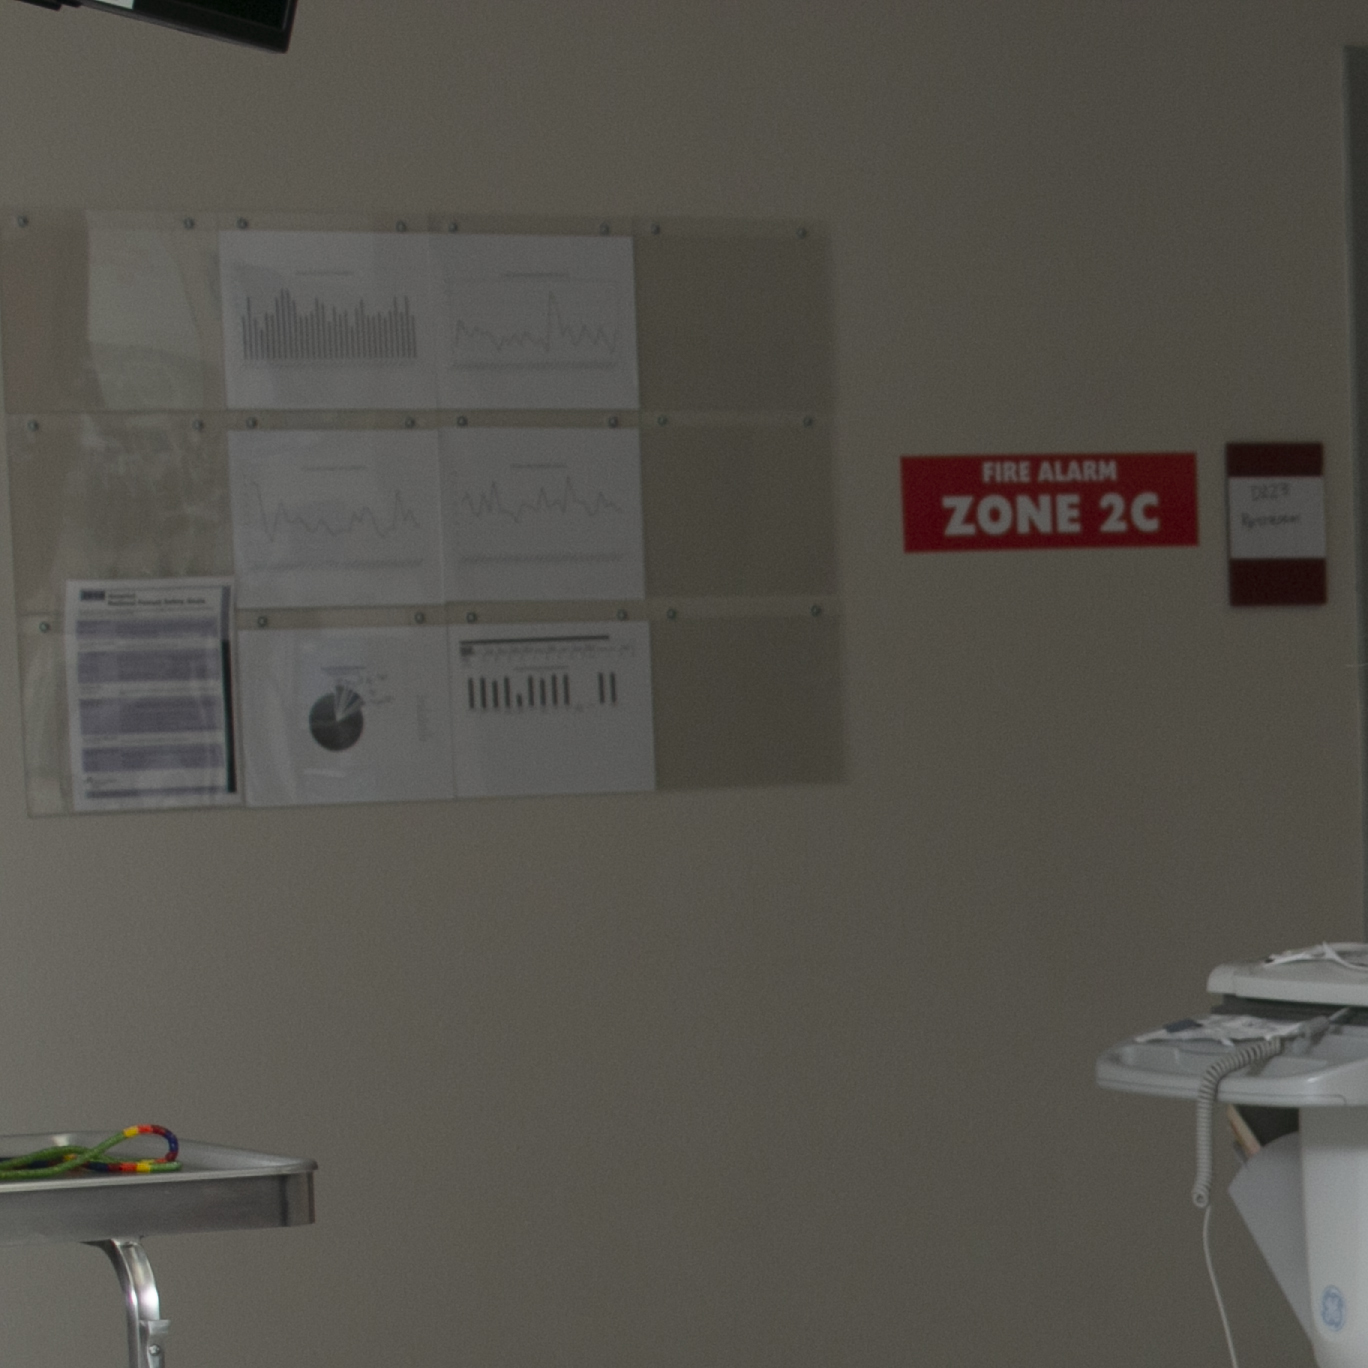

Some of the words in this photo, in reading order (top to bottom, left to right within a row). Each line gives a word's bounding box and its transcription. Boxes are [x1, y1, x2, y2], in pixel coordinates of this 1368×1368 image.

[982, 460, 1032, 484] FIRE
[1038, 458, 1119, 483] ALARM
[942, 494, 1082, 537] ZONE
[1099, 491, 1161, 534] 2C
